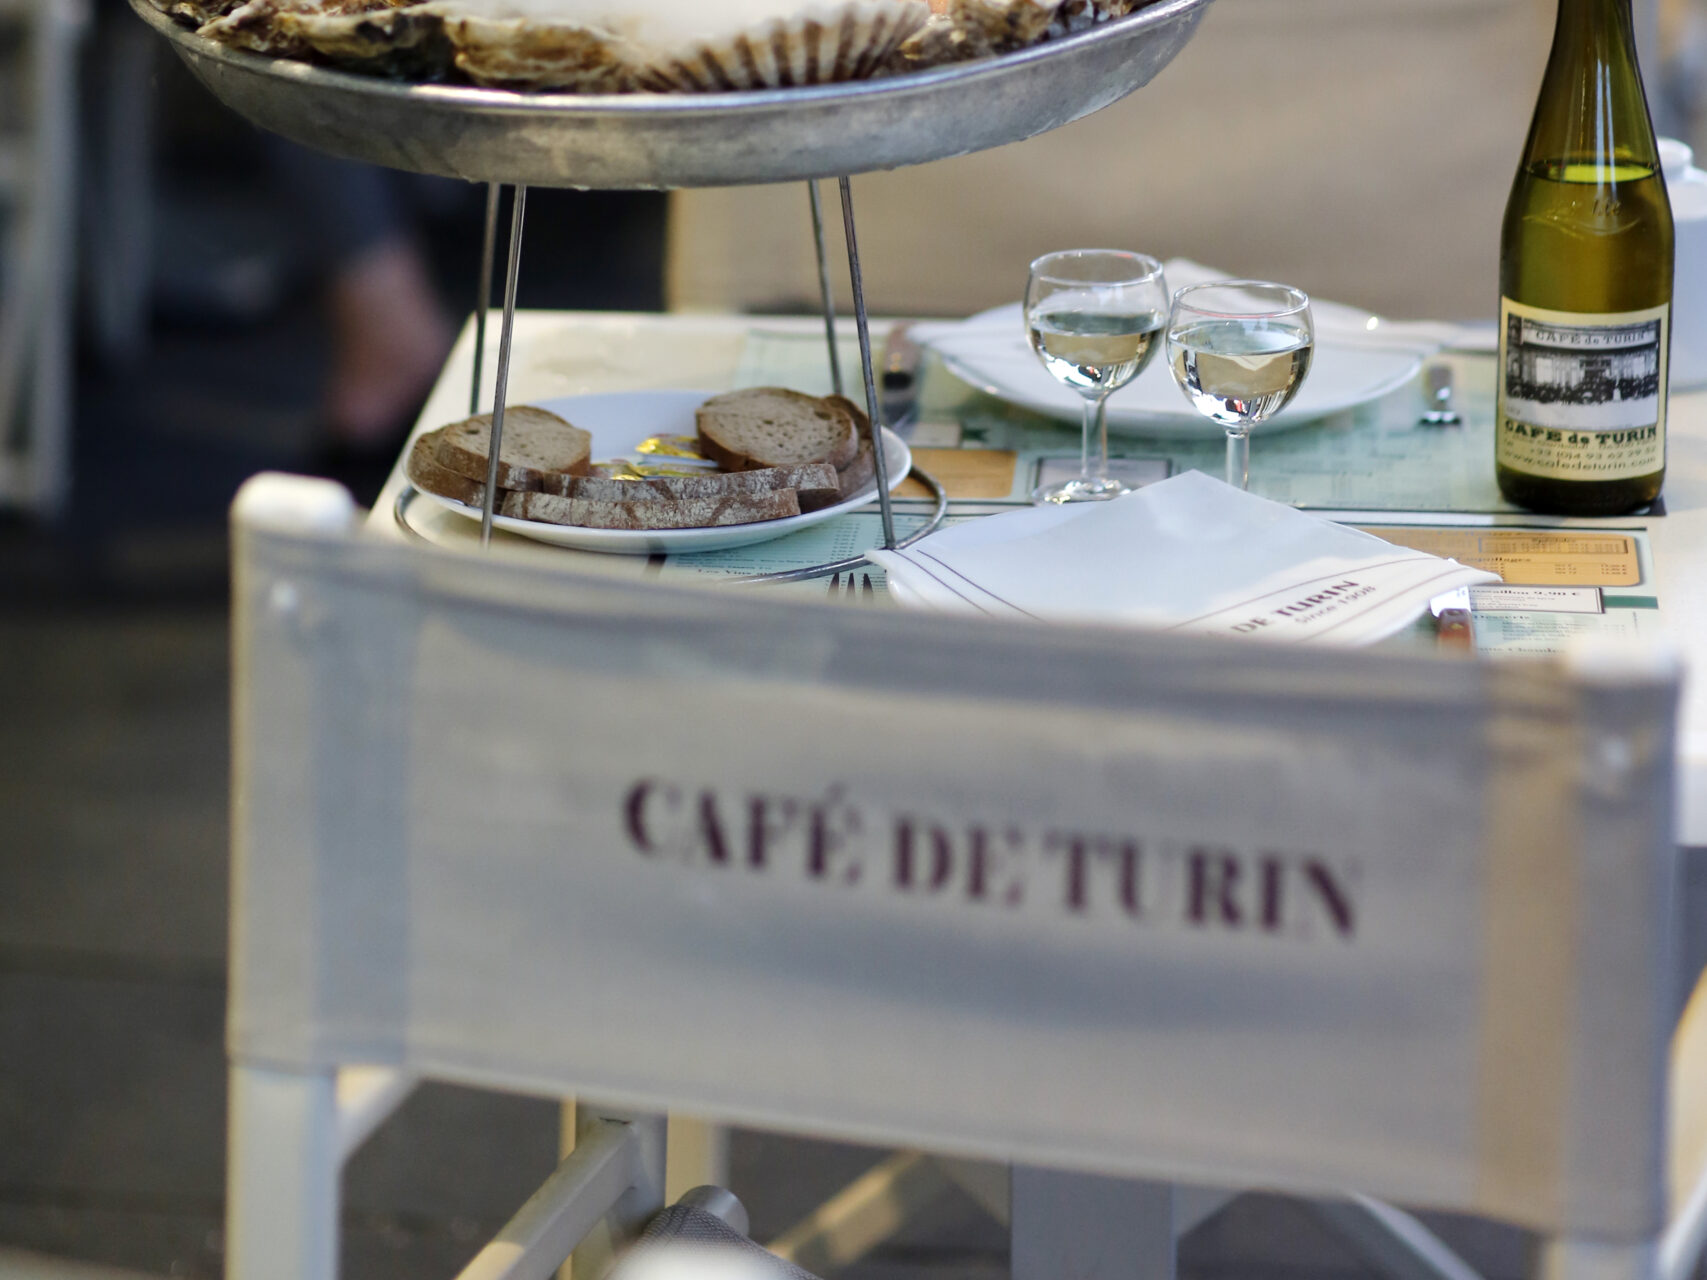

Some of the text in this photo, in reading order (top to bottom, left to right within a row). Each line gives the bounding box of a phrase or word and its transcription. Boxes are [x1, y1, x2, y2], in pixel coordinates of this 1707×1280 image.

[1603, 332, 1645, 345] TURIN
[1568, 433, 1590, 445] de
[1595, 425, 1657, 445] TURIN
[1230, 580, 1360, 634] DE TURIN
[622, 776, 1362, 938] CAFÉ DE TURIN
